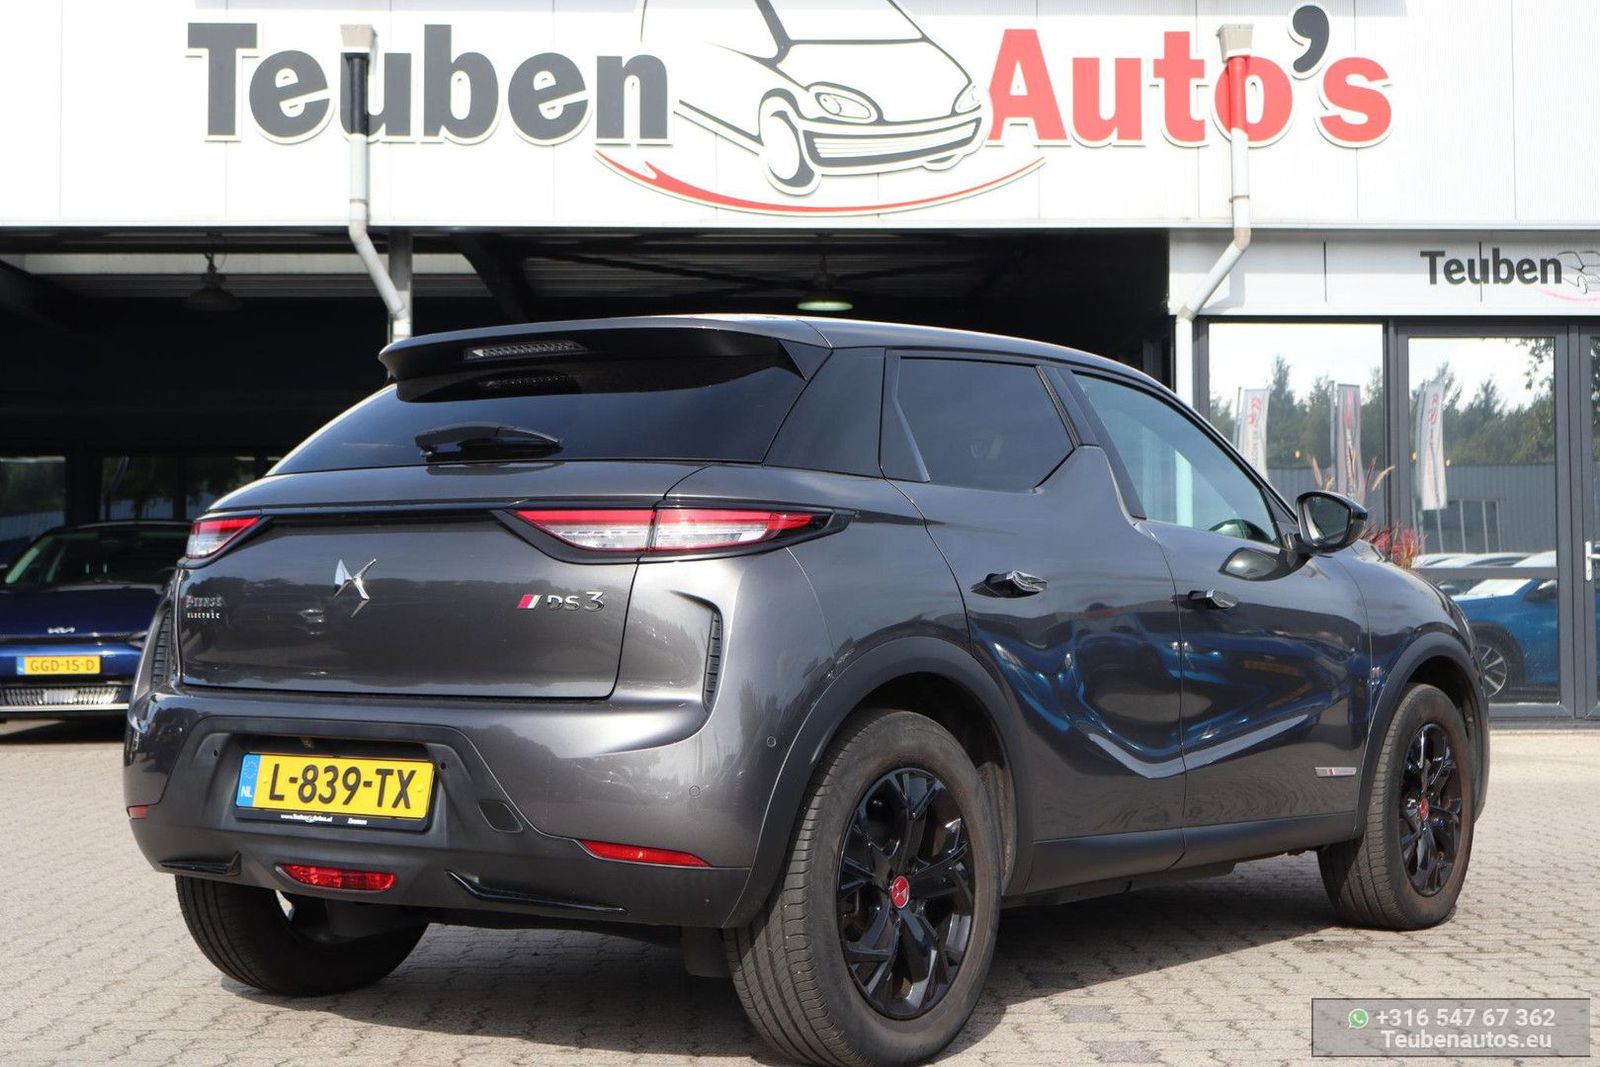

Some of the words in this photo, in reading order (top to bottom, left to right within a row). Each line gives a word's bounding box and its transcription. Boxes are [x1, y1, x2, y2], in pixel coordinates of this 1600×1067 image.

[187, 22, 669, 142] Teuben
[987, 5, 1393, 144] Auto's
[1419, 247, 1562, 285] Teuben
[30, 659, 95, 673] GGD-15-D
[240, 786, 254, 799] NL
[268, 763, 416, 810] L-839-TX
